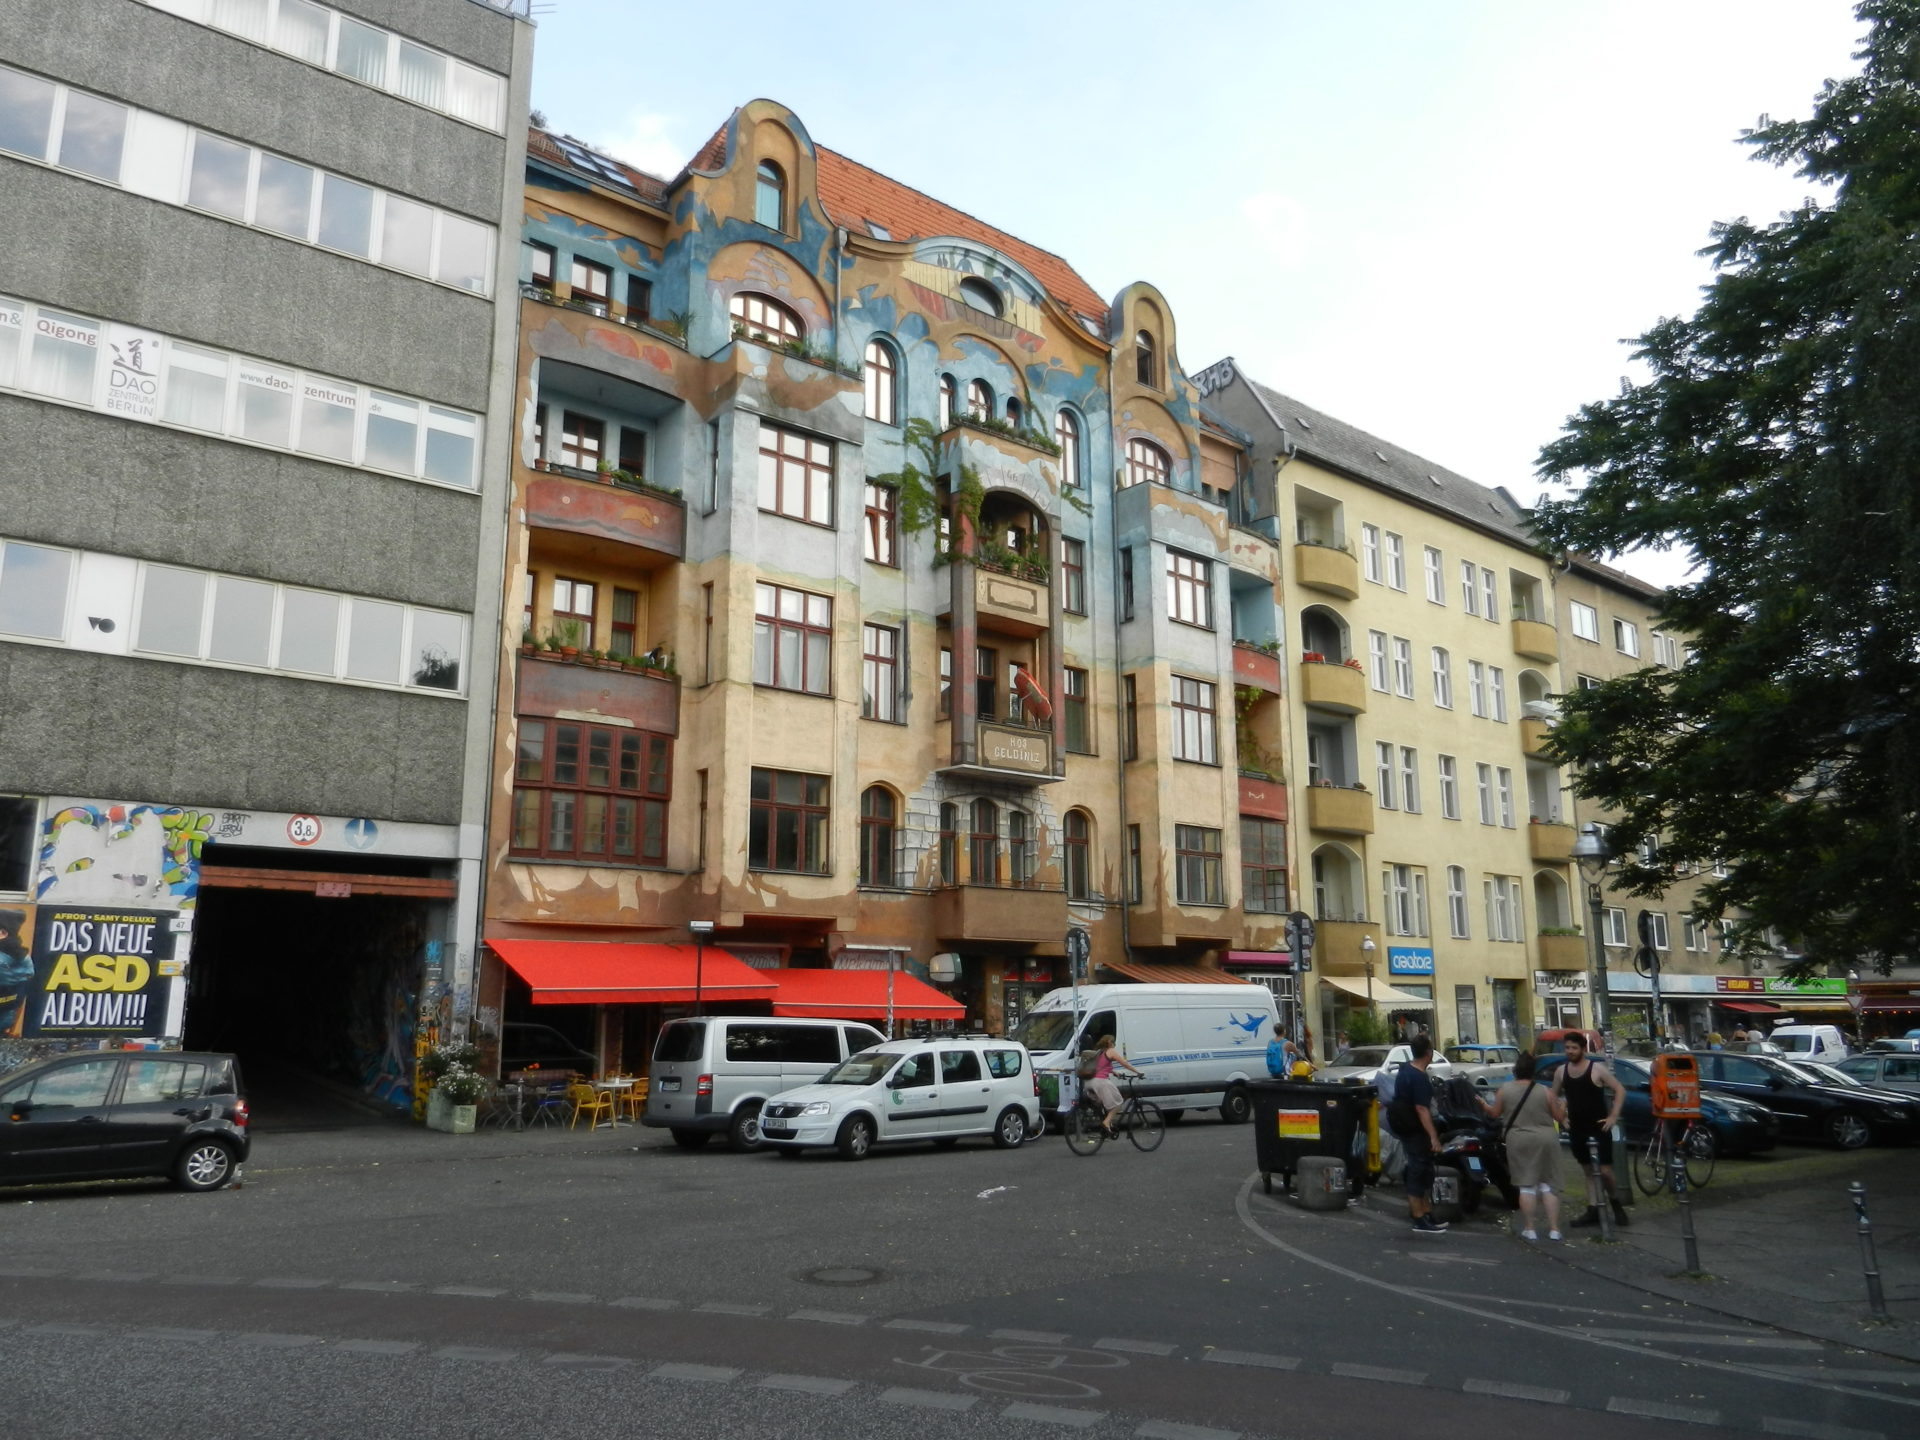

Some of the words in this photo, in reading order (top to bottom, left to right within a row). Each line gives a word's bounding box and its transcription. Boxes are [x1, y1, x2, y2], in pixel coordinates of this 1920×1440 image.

[37, 319, 97, 346] Qigong
[110, 369, 157, 395] DAO
[107, 398, 154, 417] BERLIN
[108, 388, 155, 405] ZENTRUM
[54, 912, 87, 921] AFROB
[94, 914, 119, 922] SAMY
[122, 914, 157, 924] DELUXE
[176, 921, 185, 929] 47
[50, 921, 94, 952] DAS
[99, 924, 156, 954] NEUE
[45, 954, 150, 992] ASD
[41, 993, 148, 1026] ALBUM!!!
